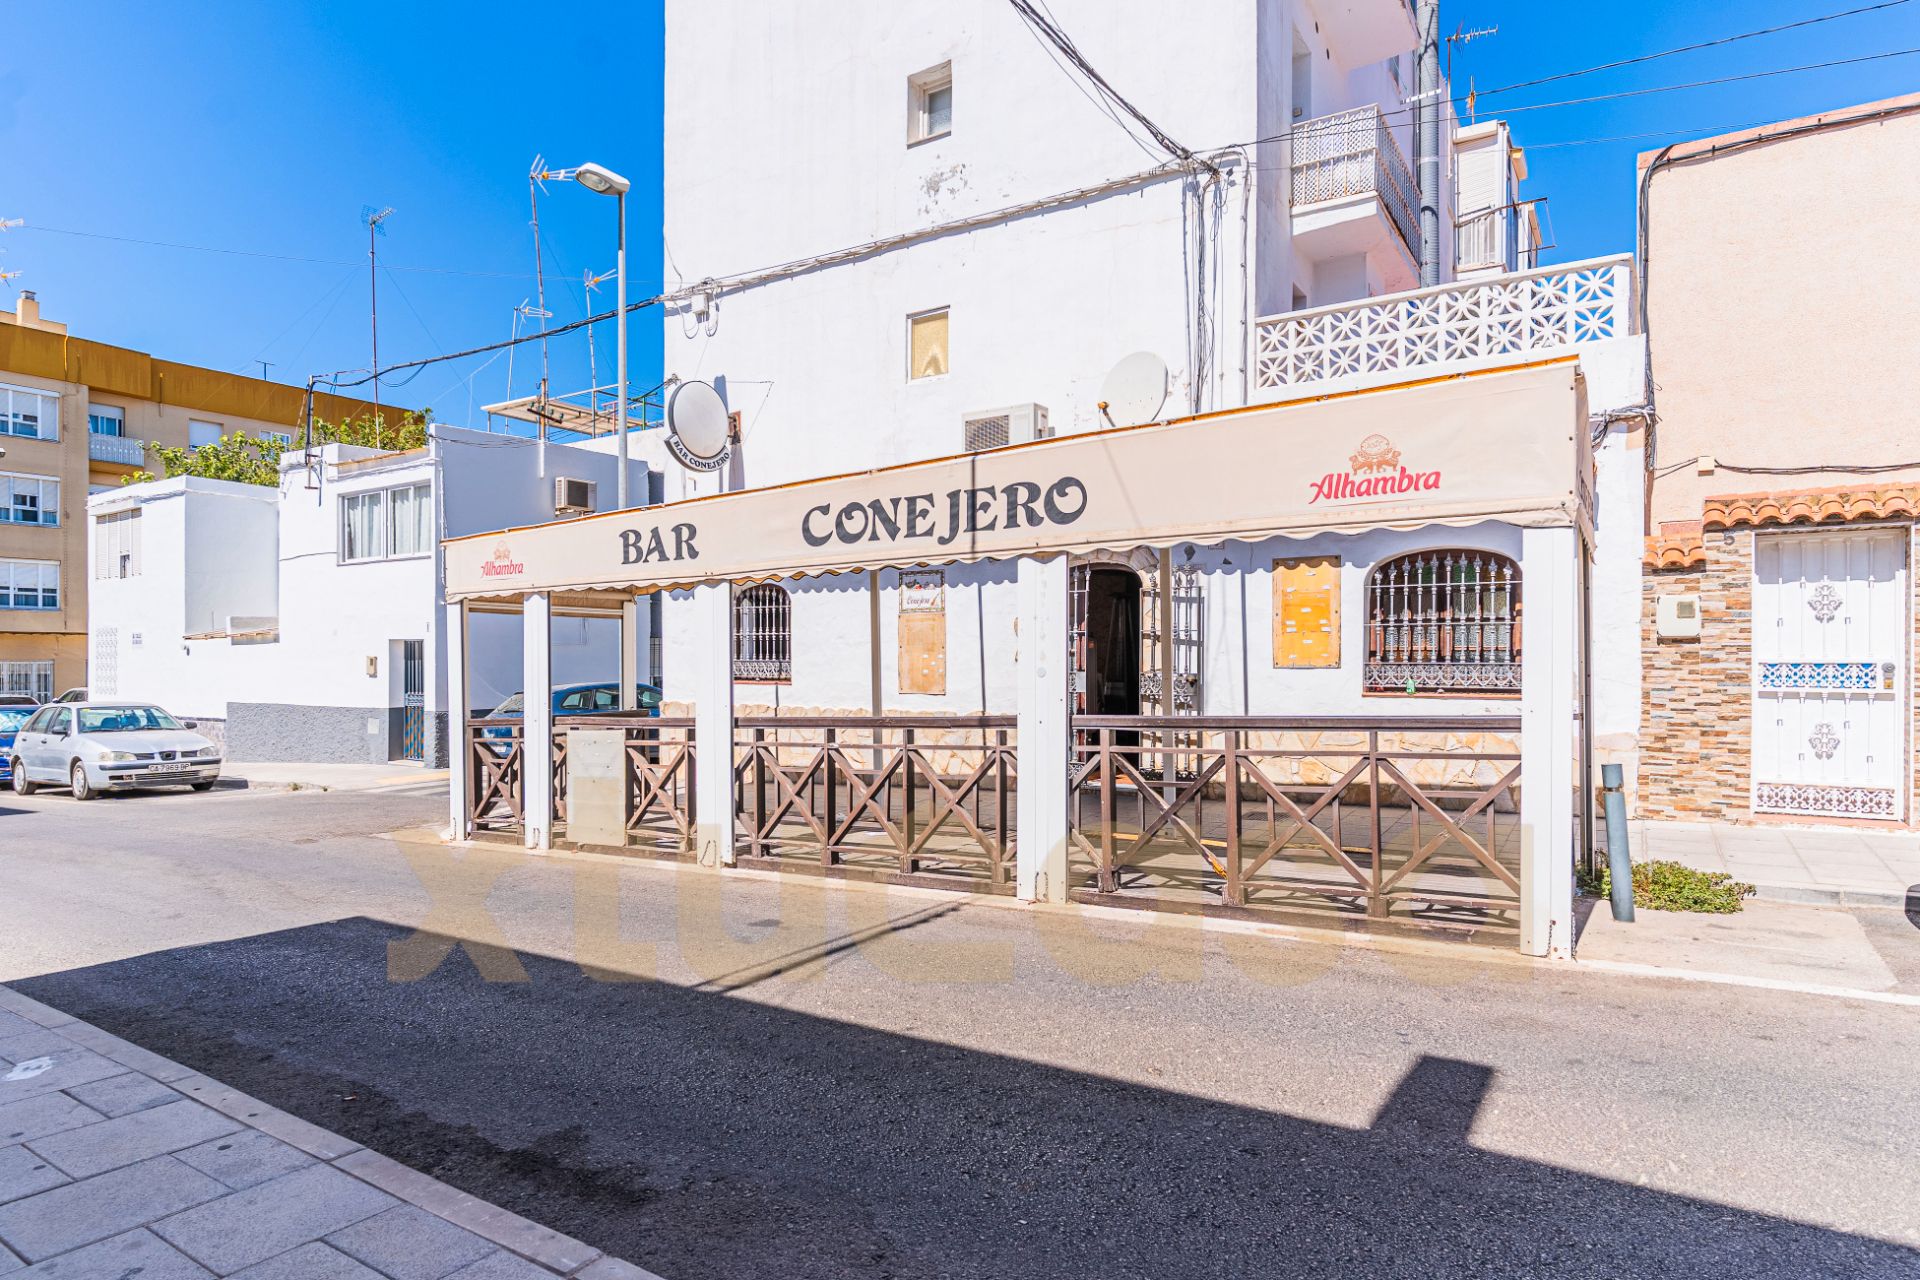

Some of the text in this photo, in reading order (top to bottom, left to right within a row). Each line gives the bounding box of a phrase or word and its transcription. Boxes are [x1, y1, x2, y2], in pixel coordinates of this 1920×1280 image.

[674, 441, 730, 469] BAR CONEJERO
[1308, 466, 1441, 504] Alhambra
[619, 476, 1088, 565] BAR CONEJERO
[480, 559, 524, 578] Alhambra
